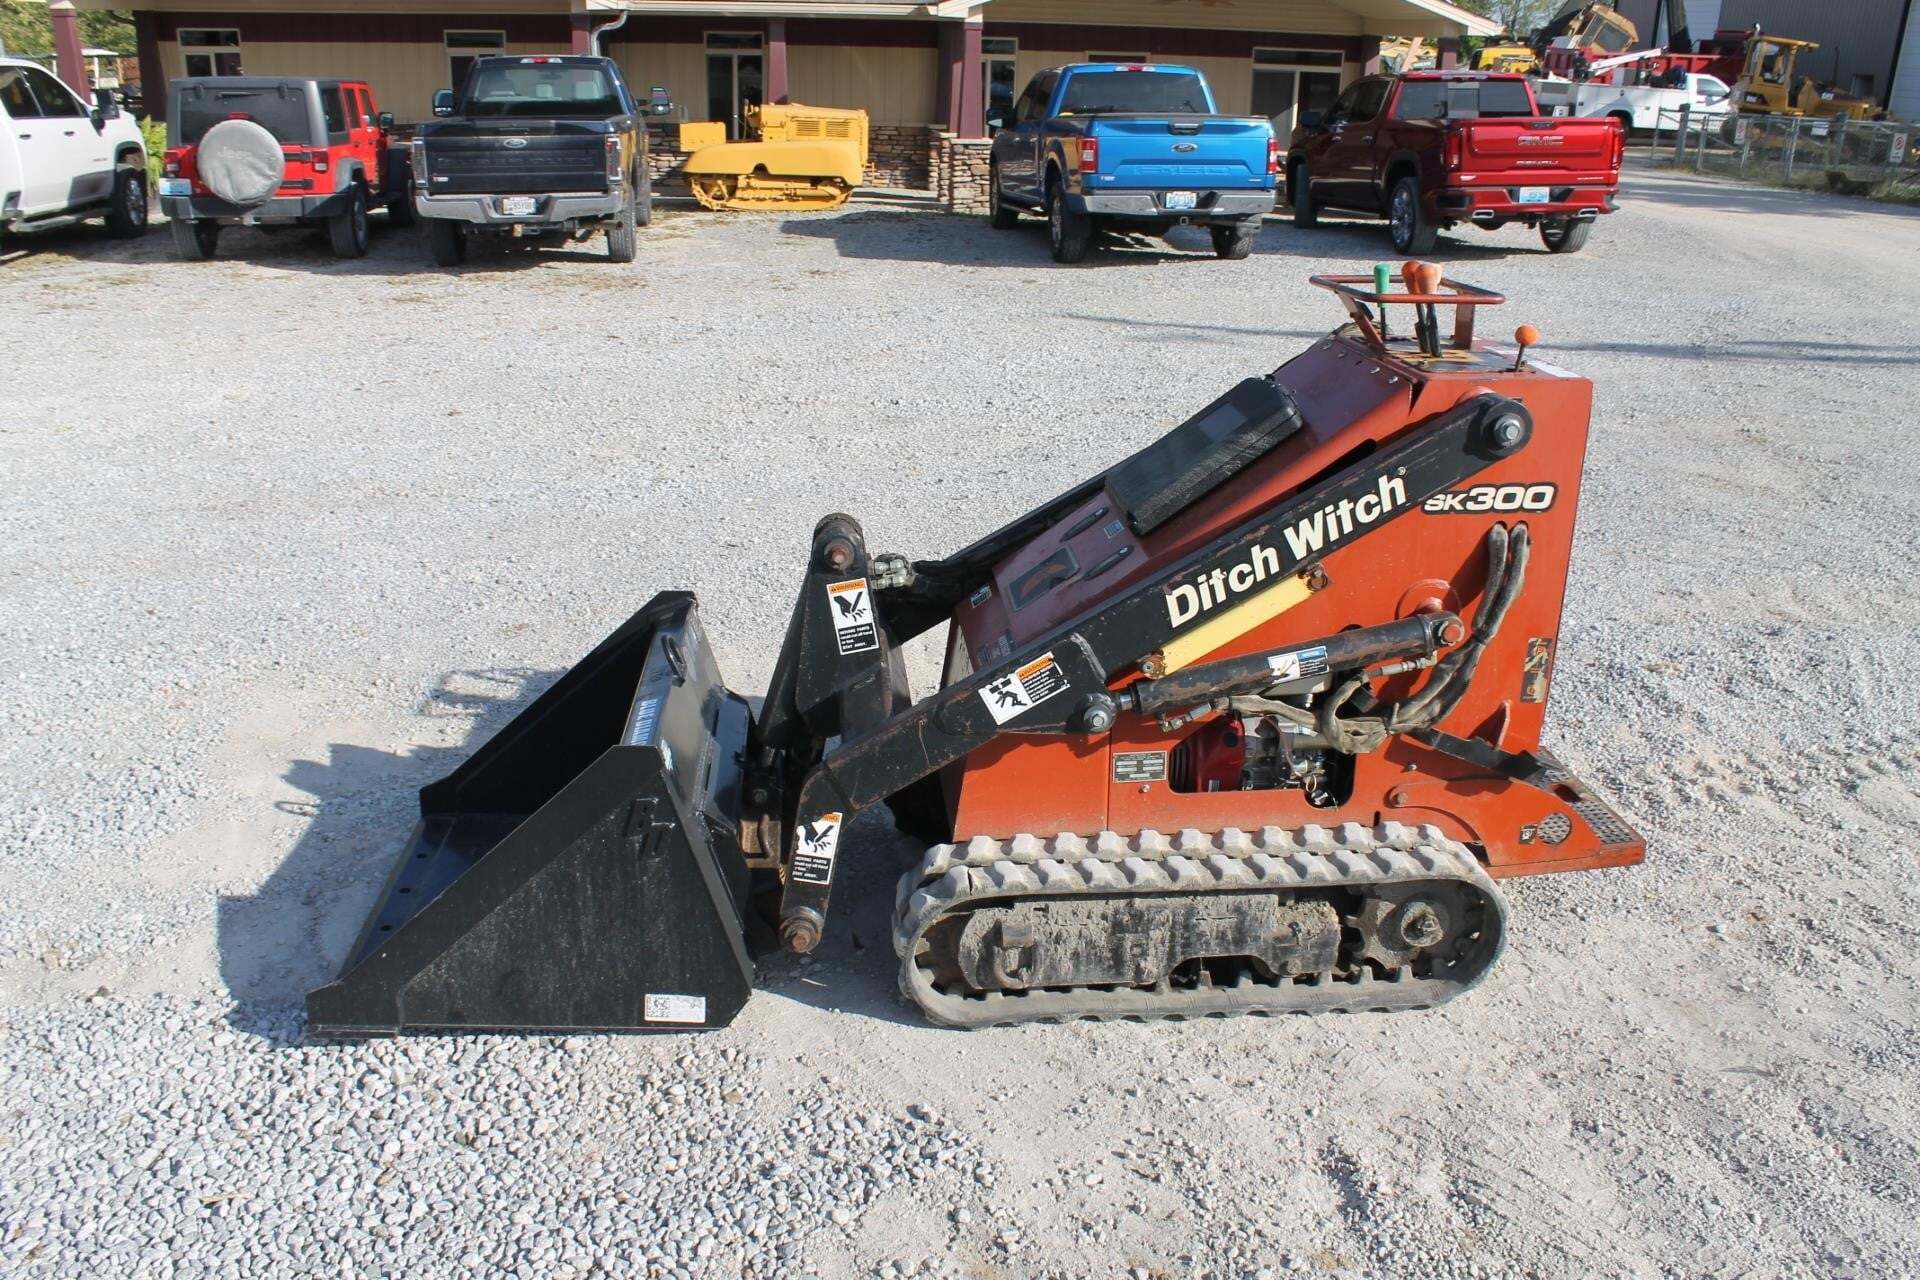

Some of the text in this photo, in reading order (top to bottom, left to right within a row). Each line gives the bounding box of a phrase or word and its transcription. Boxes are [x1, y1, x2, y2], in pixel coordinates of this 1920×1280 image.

[1517, 135, 1565, 146] GMC
[1423, 485, 1555, 511] SK300
[1165, 474, 1406, 629] Ditch Witch
